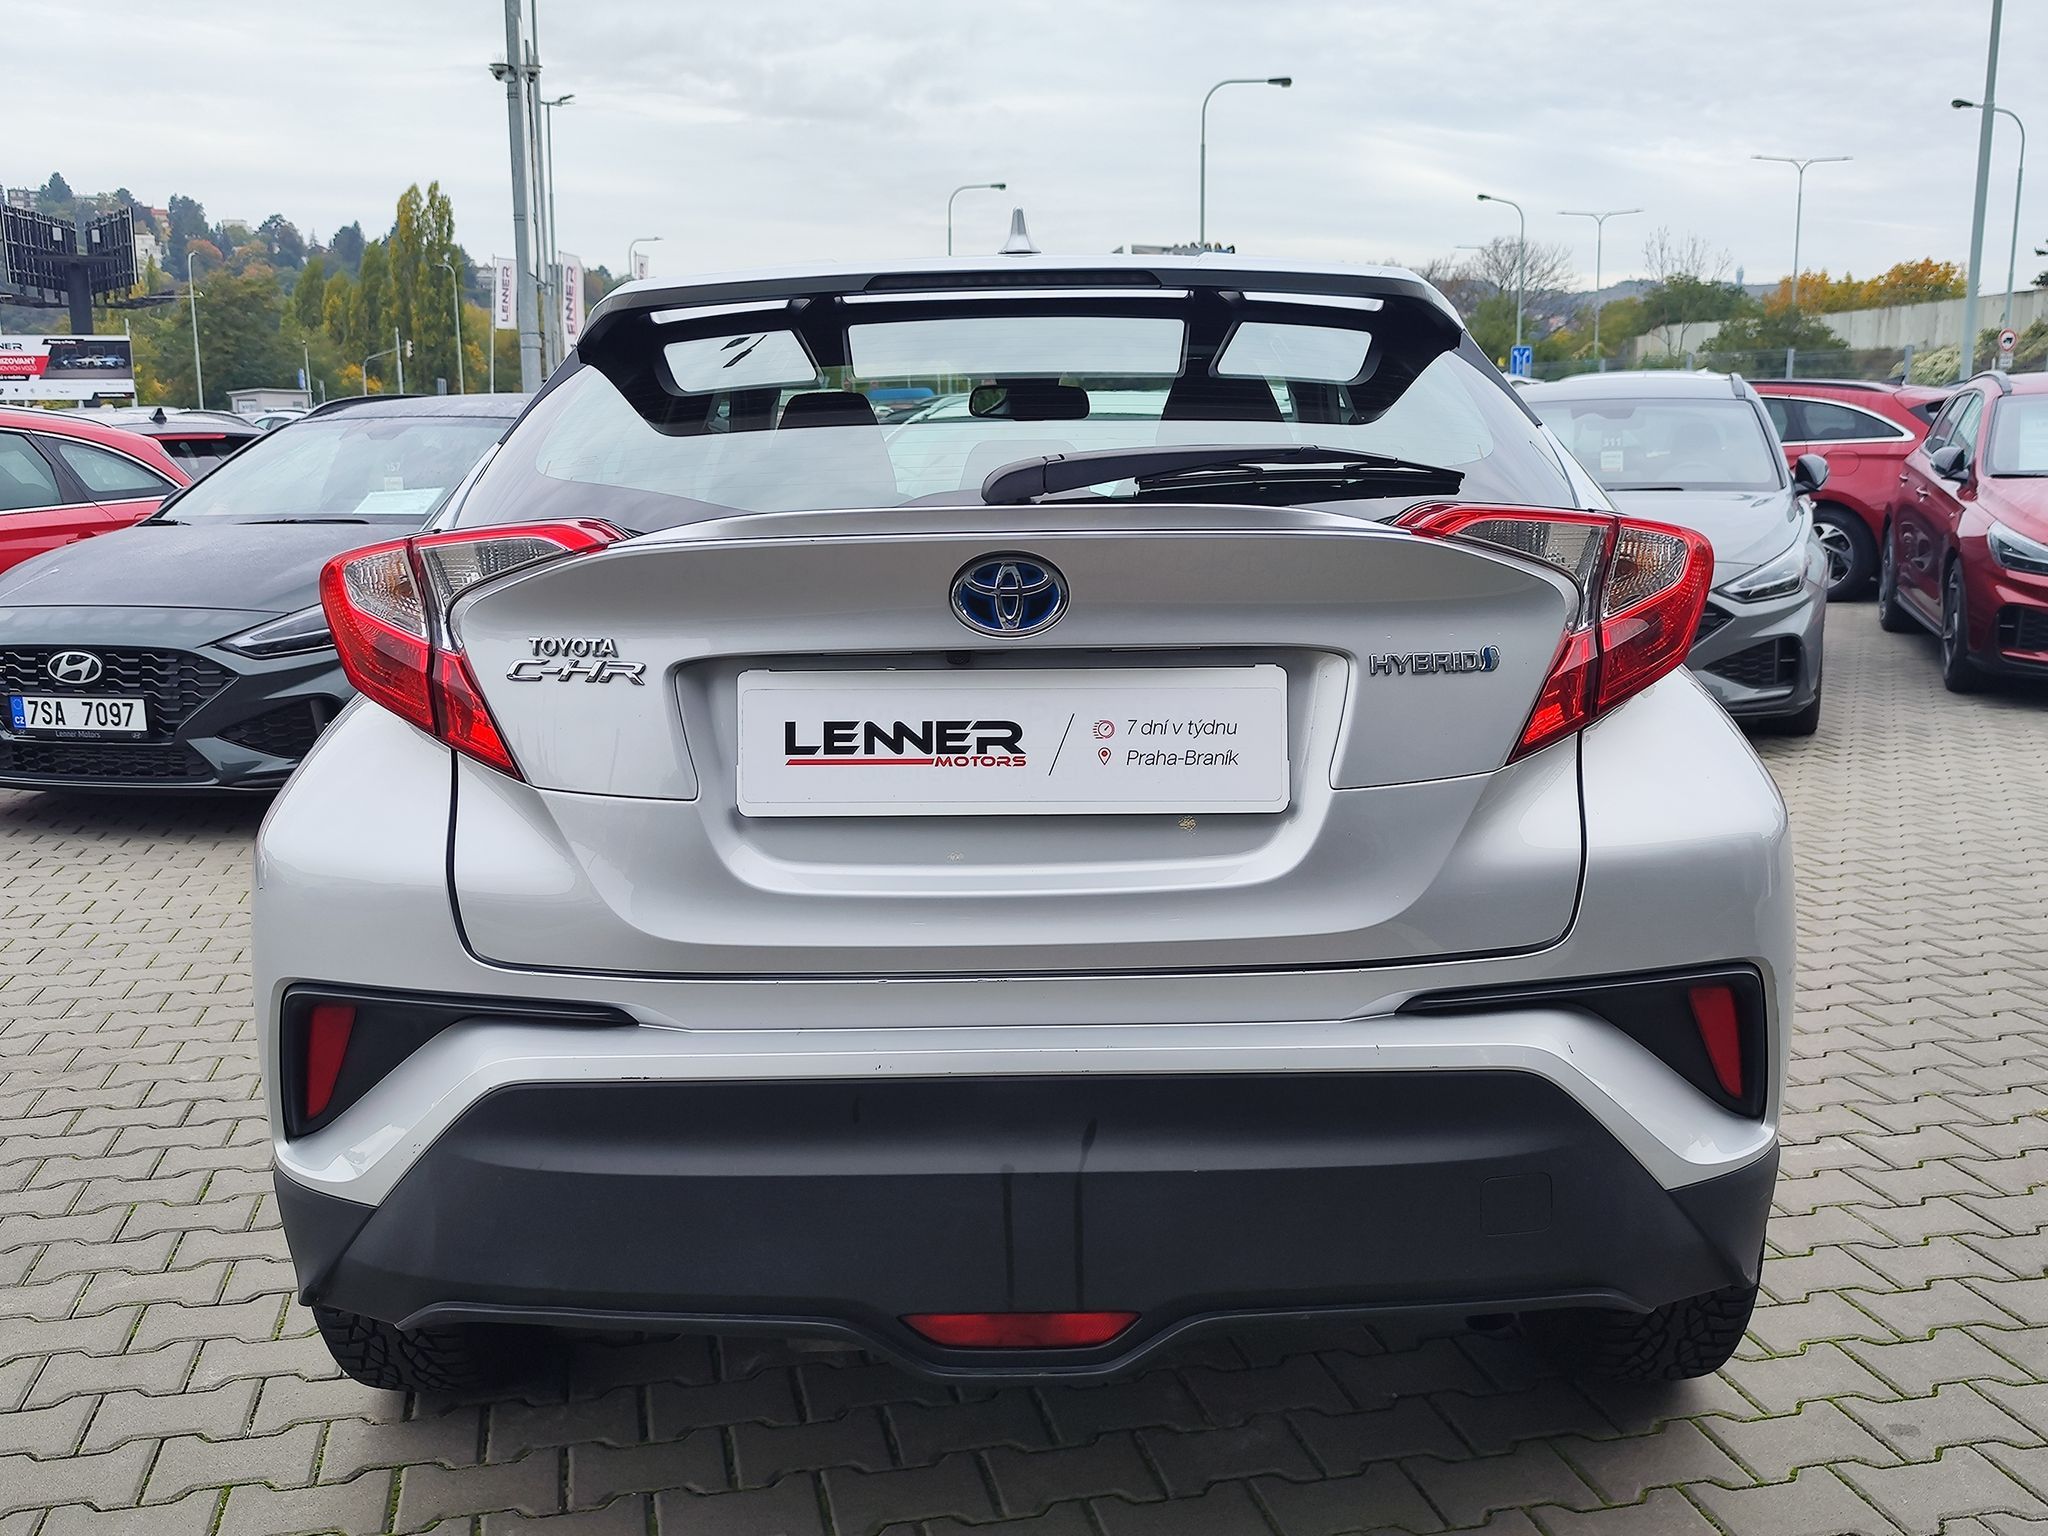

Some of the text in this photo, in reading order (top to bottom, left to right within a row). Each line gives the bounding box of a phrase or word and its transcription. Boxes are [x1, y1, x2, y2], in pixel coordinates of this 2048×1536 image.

[501, 265, 511, 322] LENNER
[528, 636, 619, 658] TOYOTA
[505, 658, 647, 686] C-HR
[1369, 651, 1481, 676] HYBRID
[14, 715, 26, 725] CZ
[27, 700, 134, 728] 7SA 7097
[55, 730, 102, 739] Lenner Motors
[784, 720, 1027, 756] LENNER
[1126, 718, 1238, 739] 7 dní v týdnu
[933, 755, 1027, 767] MOTORS
[1126, 748, 1240, 766] Praha-Braník
